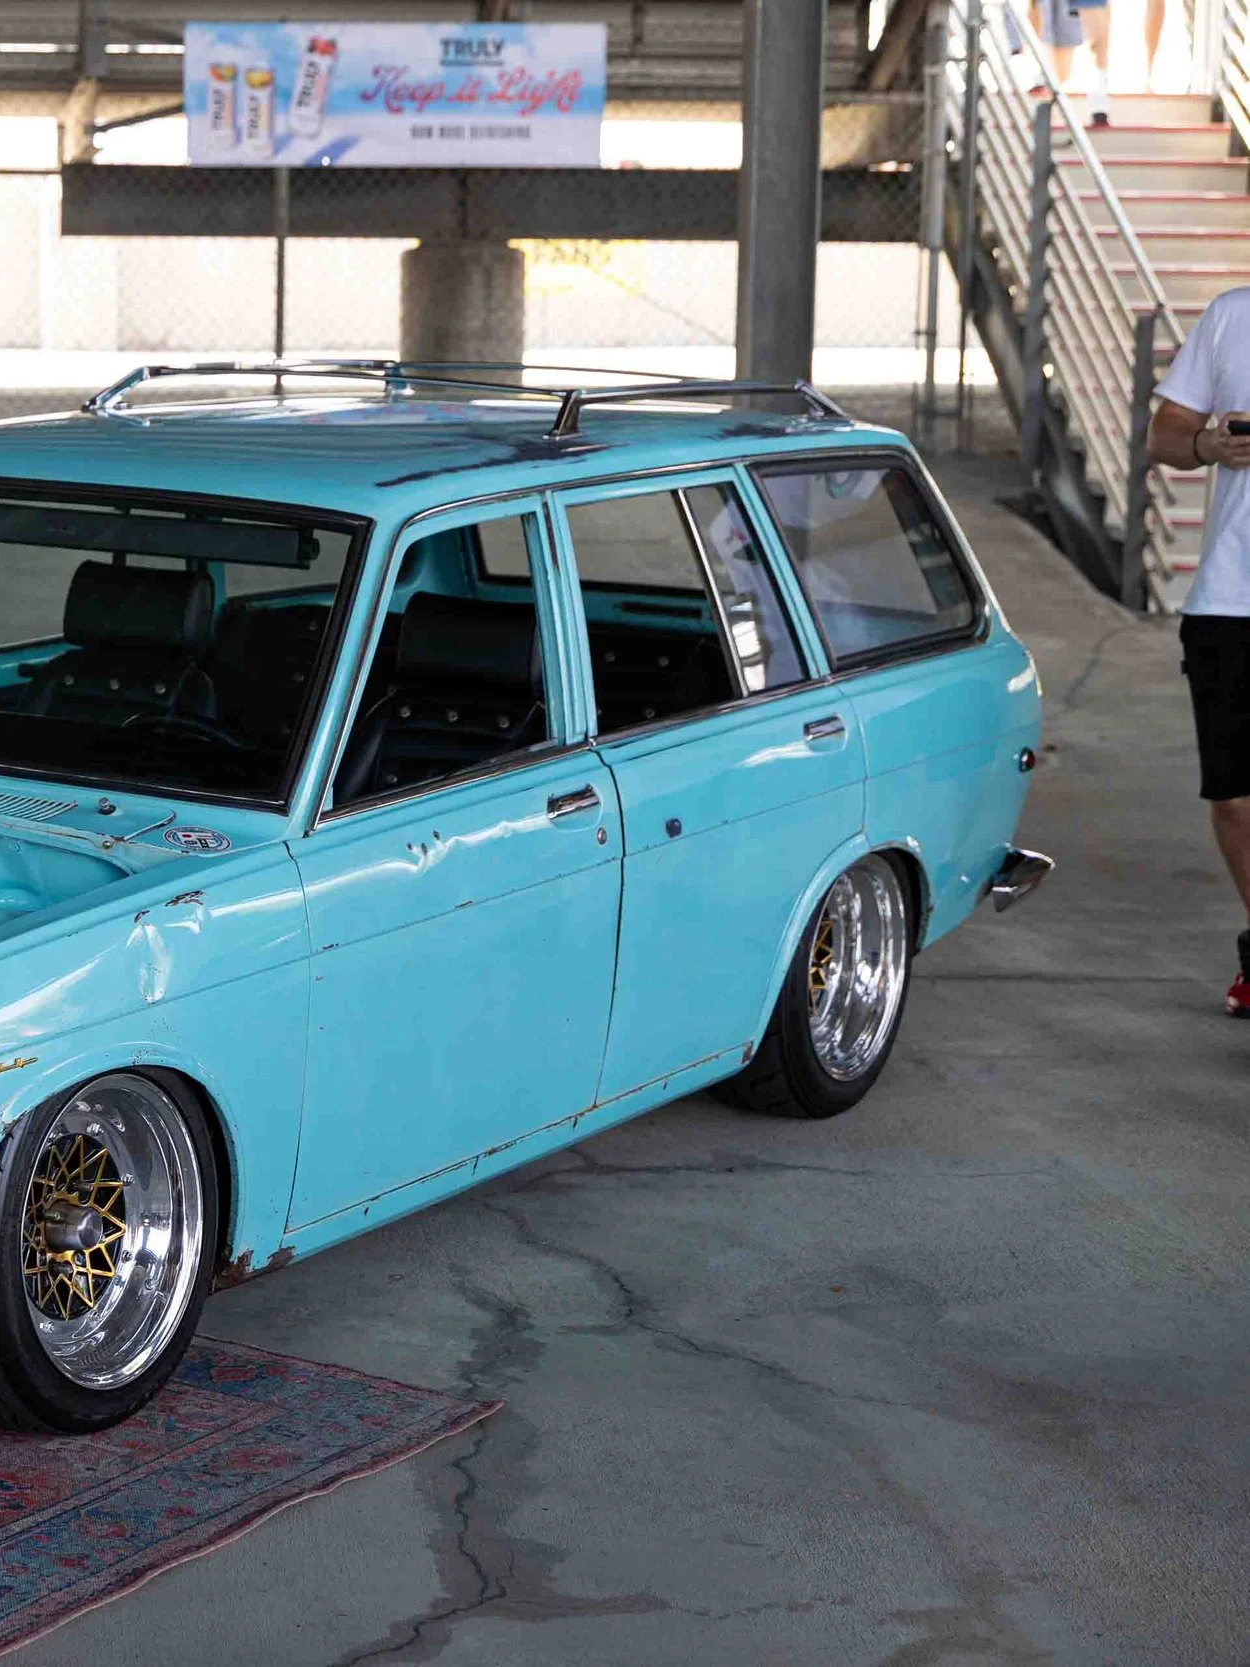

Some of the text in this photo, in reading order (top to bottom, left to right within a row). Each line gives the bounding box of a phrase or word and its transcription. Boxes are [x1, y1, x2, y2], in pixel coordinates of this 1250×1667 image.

[441, 38, 505, 58] TRULY
[359, 64, 446, 115] Keep
[485, 65, 583, 117] Light
